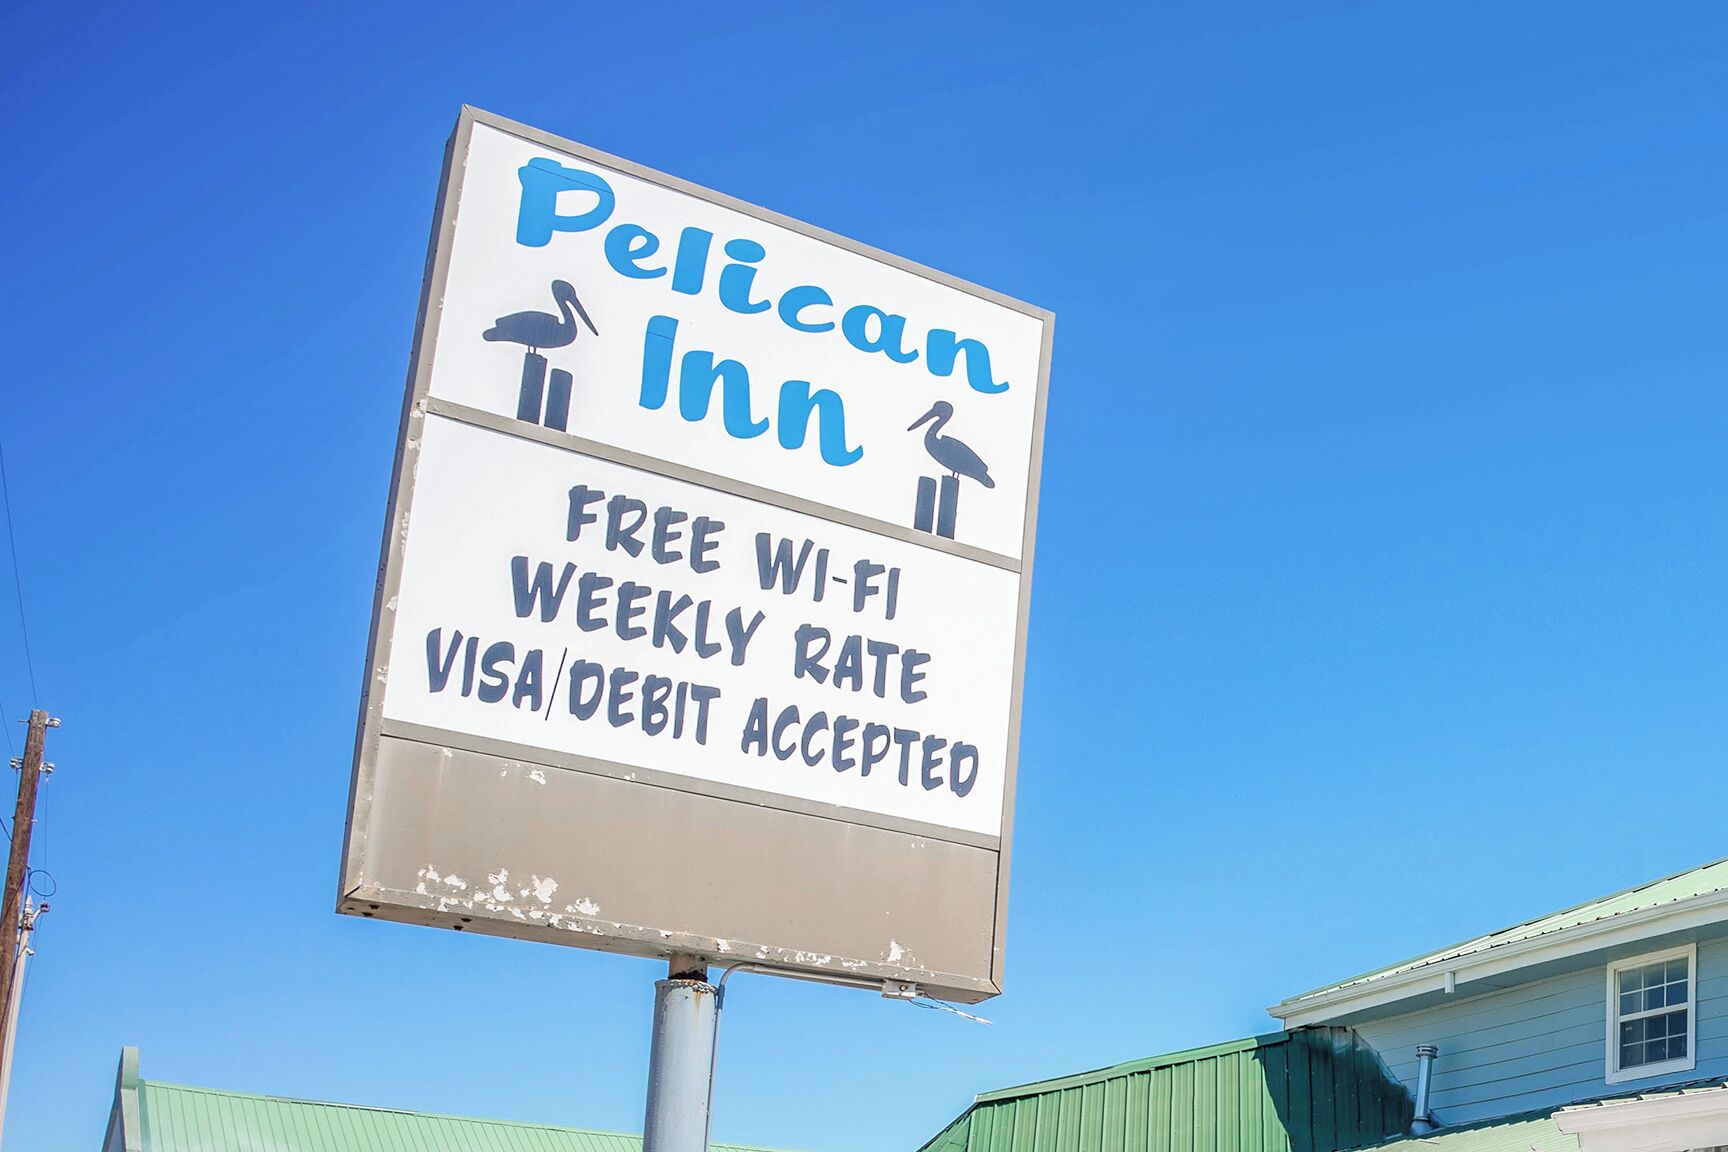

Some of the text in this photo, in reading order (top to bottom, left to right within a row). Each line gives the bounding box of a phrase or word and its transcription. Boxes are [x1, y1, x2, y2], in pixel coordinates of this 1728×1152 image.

[516, 157, 1009, 394] Pelican
[639, 315, 863, 466] Inn
[567, 485, 900, 620] FREE WI-FI
[511, 556, 930, 703] WEEKLY RATE
[427, 628, 978, 797] VISA/DEBIT ACCEPTED
